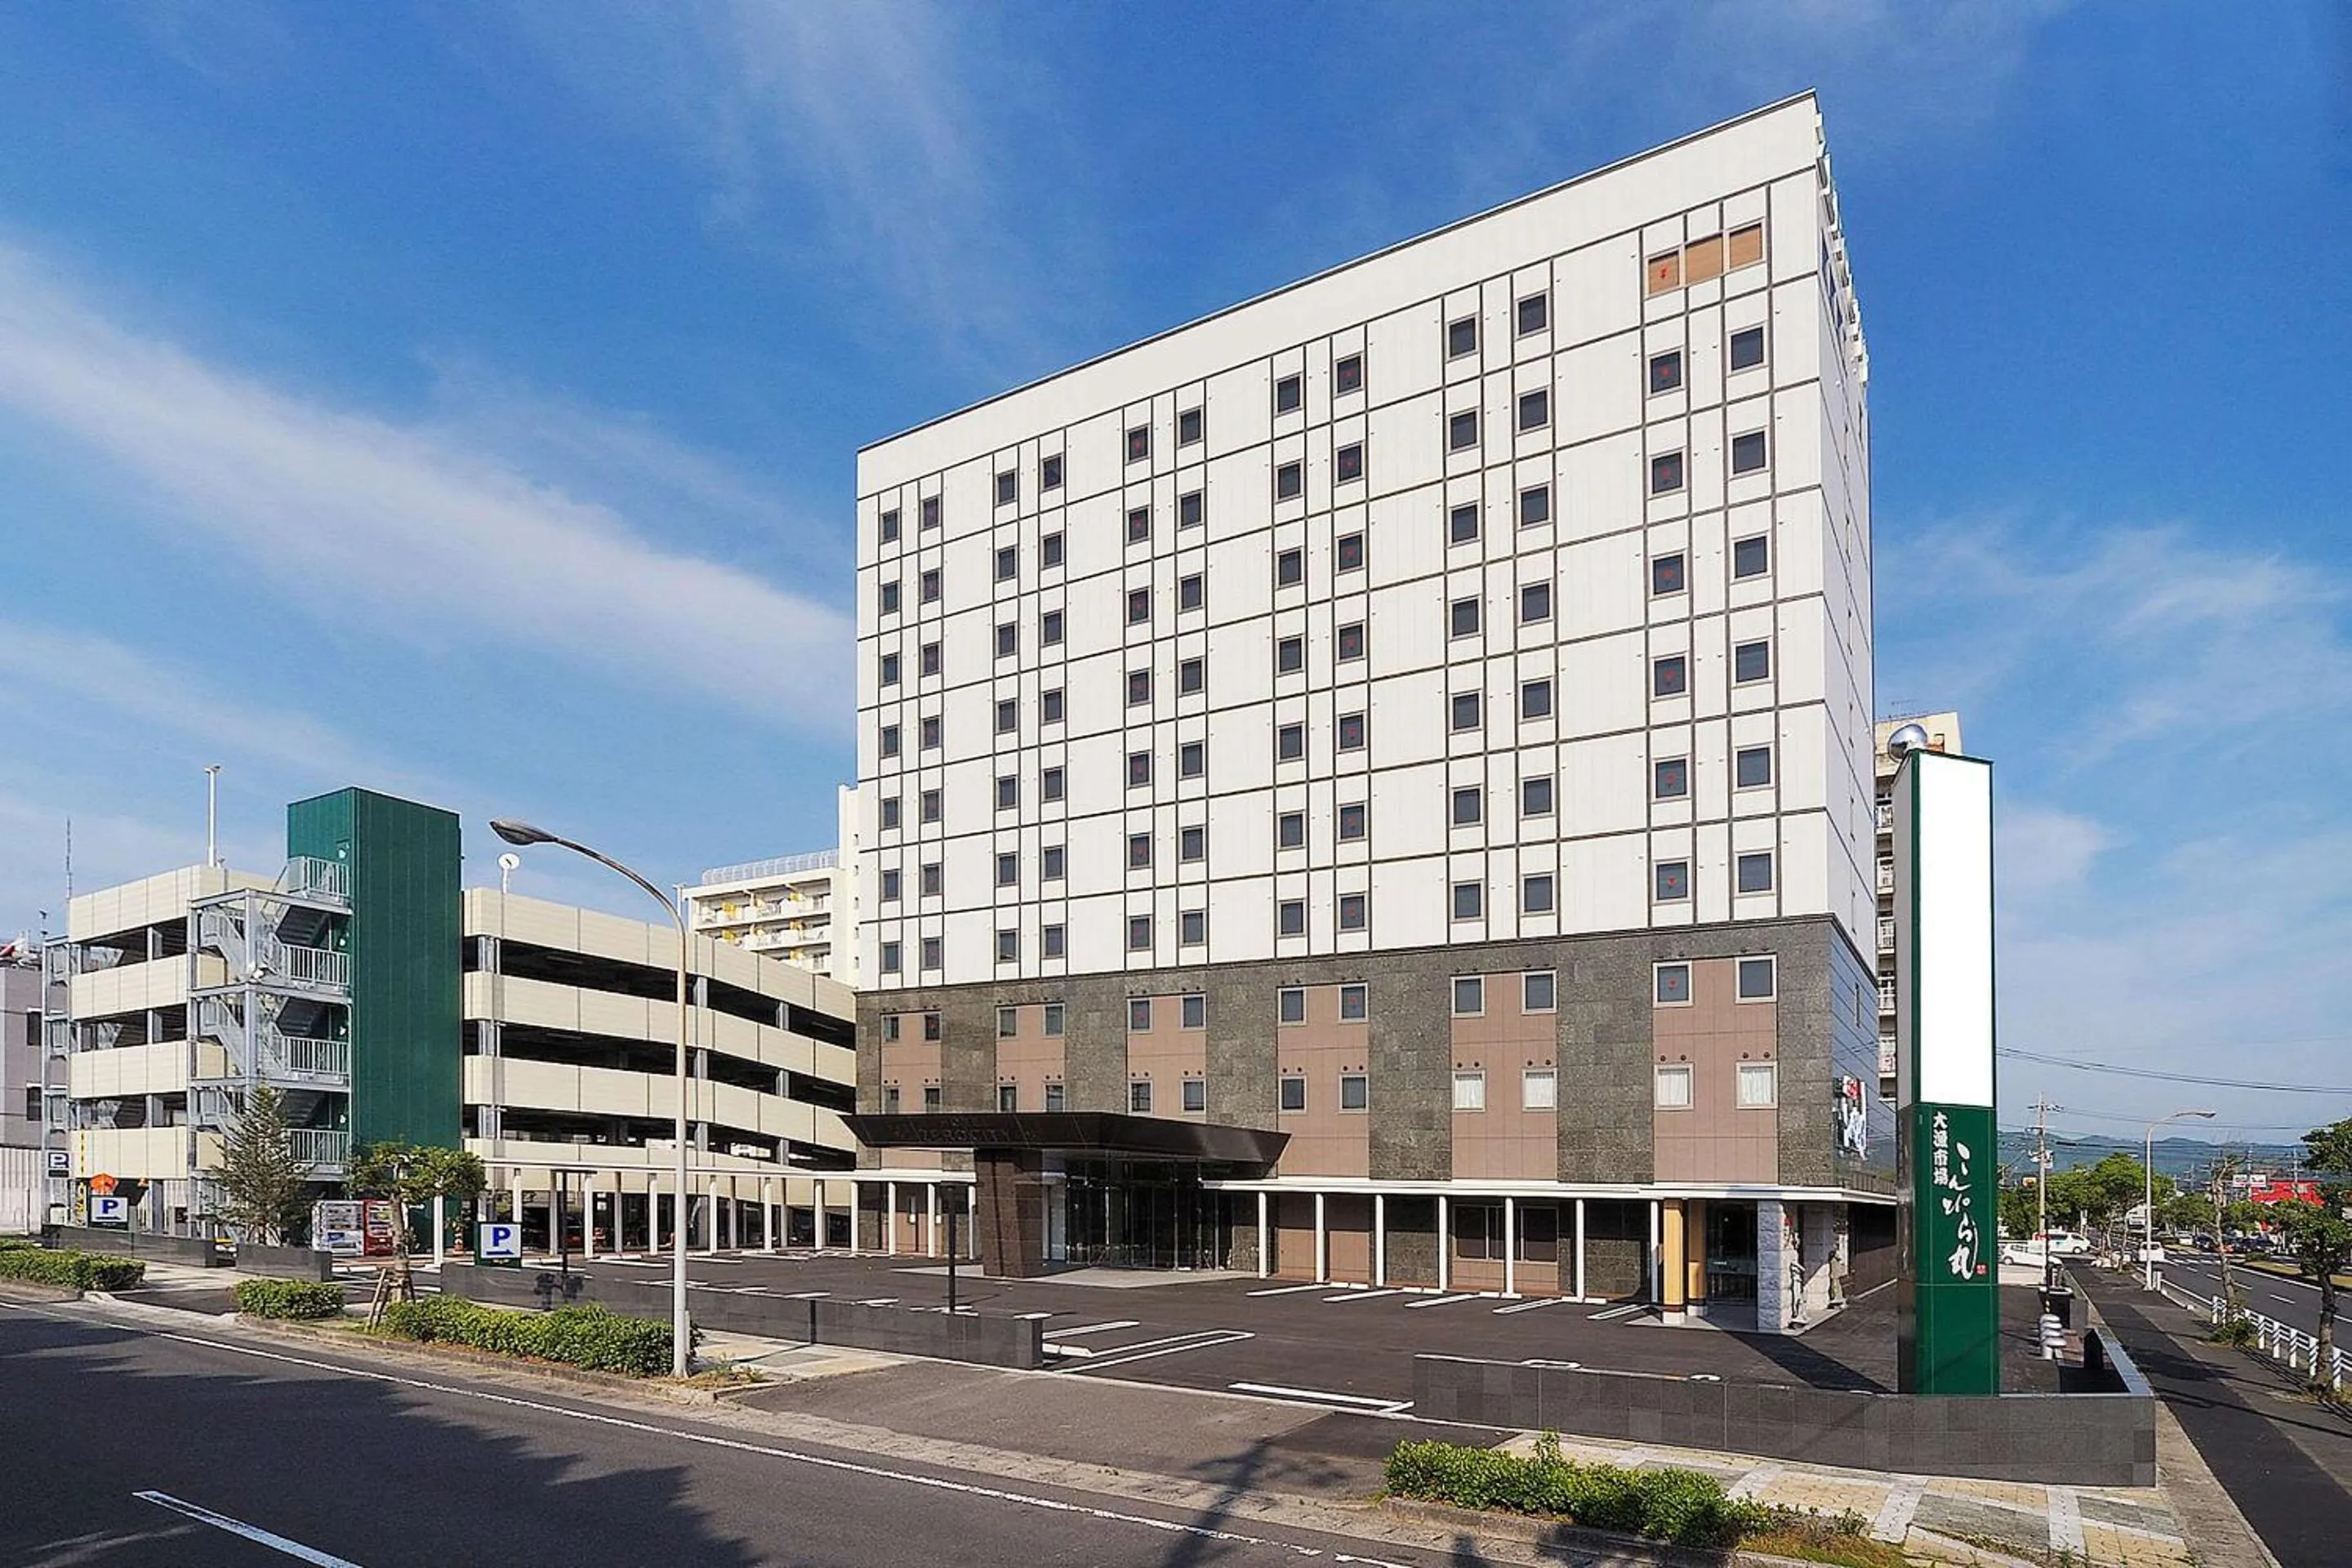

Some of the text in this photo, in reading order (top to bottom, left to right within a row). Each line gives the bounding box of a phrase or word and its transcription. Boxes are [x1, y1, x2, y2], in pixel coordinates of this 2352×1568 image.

[50, 1153, 67, 1168] P
[102, 1199, 118, 1214] P
[492, 1227, 511, 1247] P
